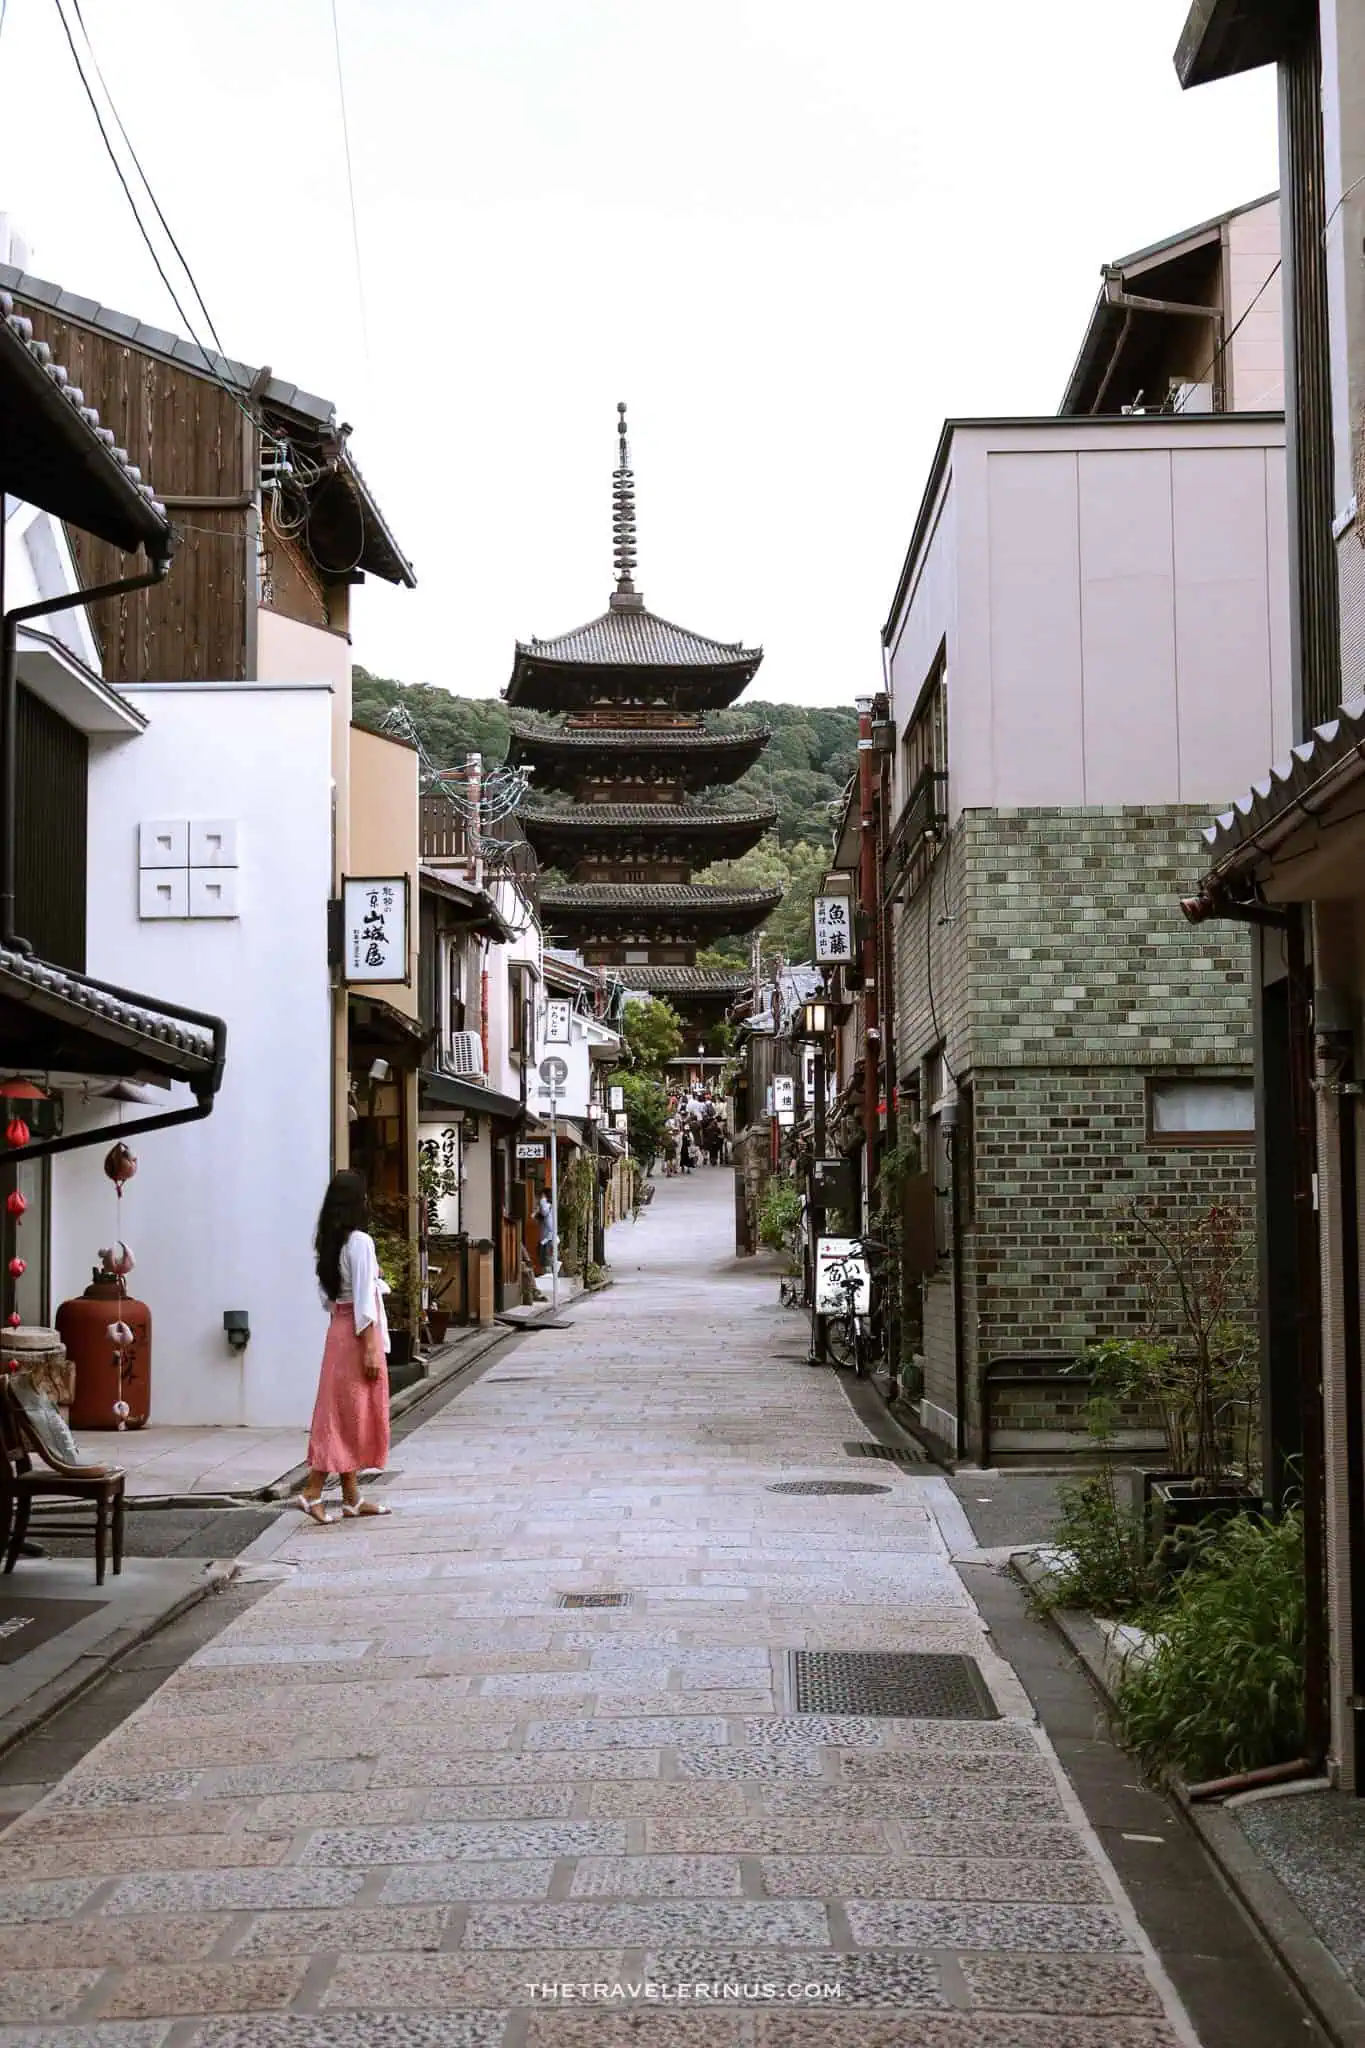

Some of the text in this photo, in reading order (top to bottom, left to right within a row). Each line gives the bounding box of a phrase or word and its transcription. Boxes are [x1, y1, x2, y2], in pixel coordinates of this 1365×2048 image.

[361, 888, 389, 966] 京山城屋
[828, 904, 848, 954] 魚藤
